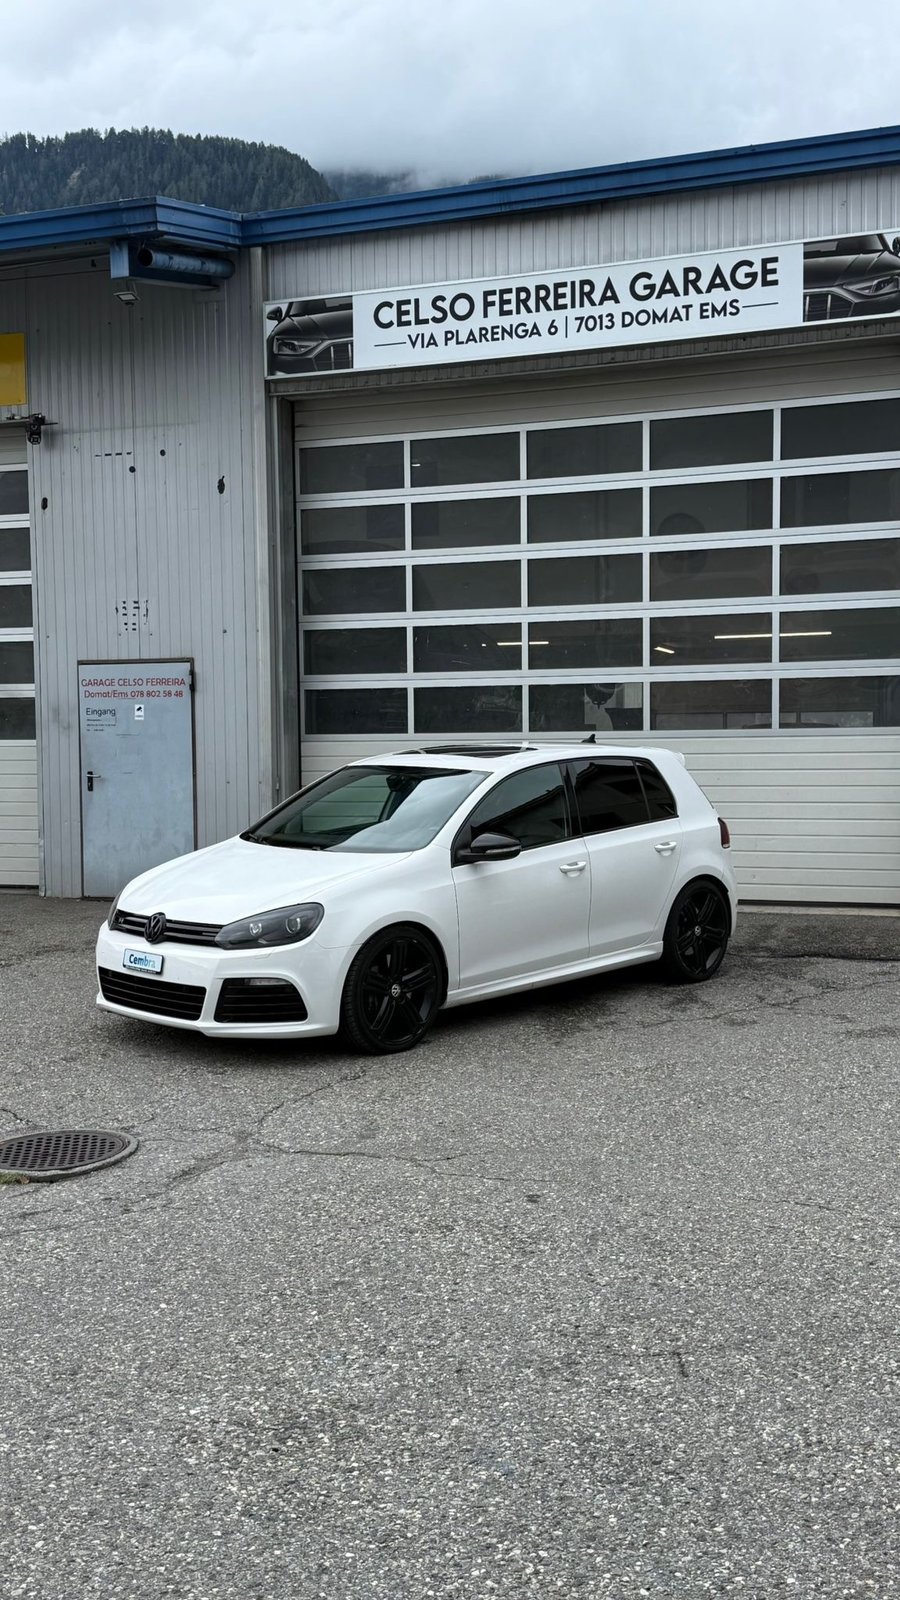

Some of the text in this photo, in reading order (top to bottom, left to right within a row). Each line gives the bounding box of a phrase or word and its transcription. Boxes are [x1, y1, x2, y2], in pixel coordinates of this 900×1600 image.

[373, 256, 779, 329] CELSO FERREIRA GARAGE
[407, 299, 740, 349] VIA PLARENGA 6 7013 DOMAT EMS
[81, 678, 185, 687] GARAGE CELSO FERREIRA
[84, 690, 184, 699] Domat/Ems 078 802 58 48
[86, 708, 116, 717] Eingang
[129, 954, 156, 969] Cembra
